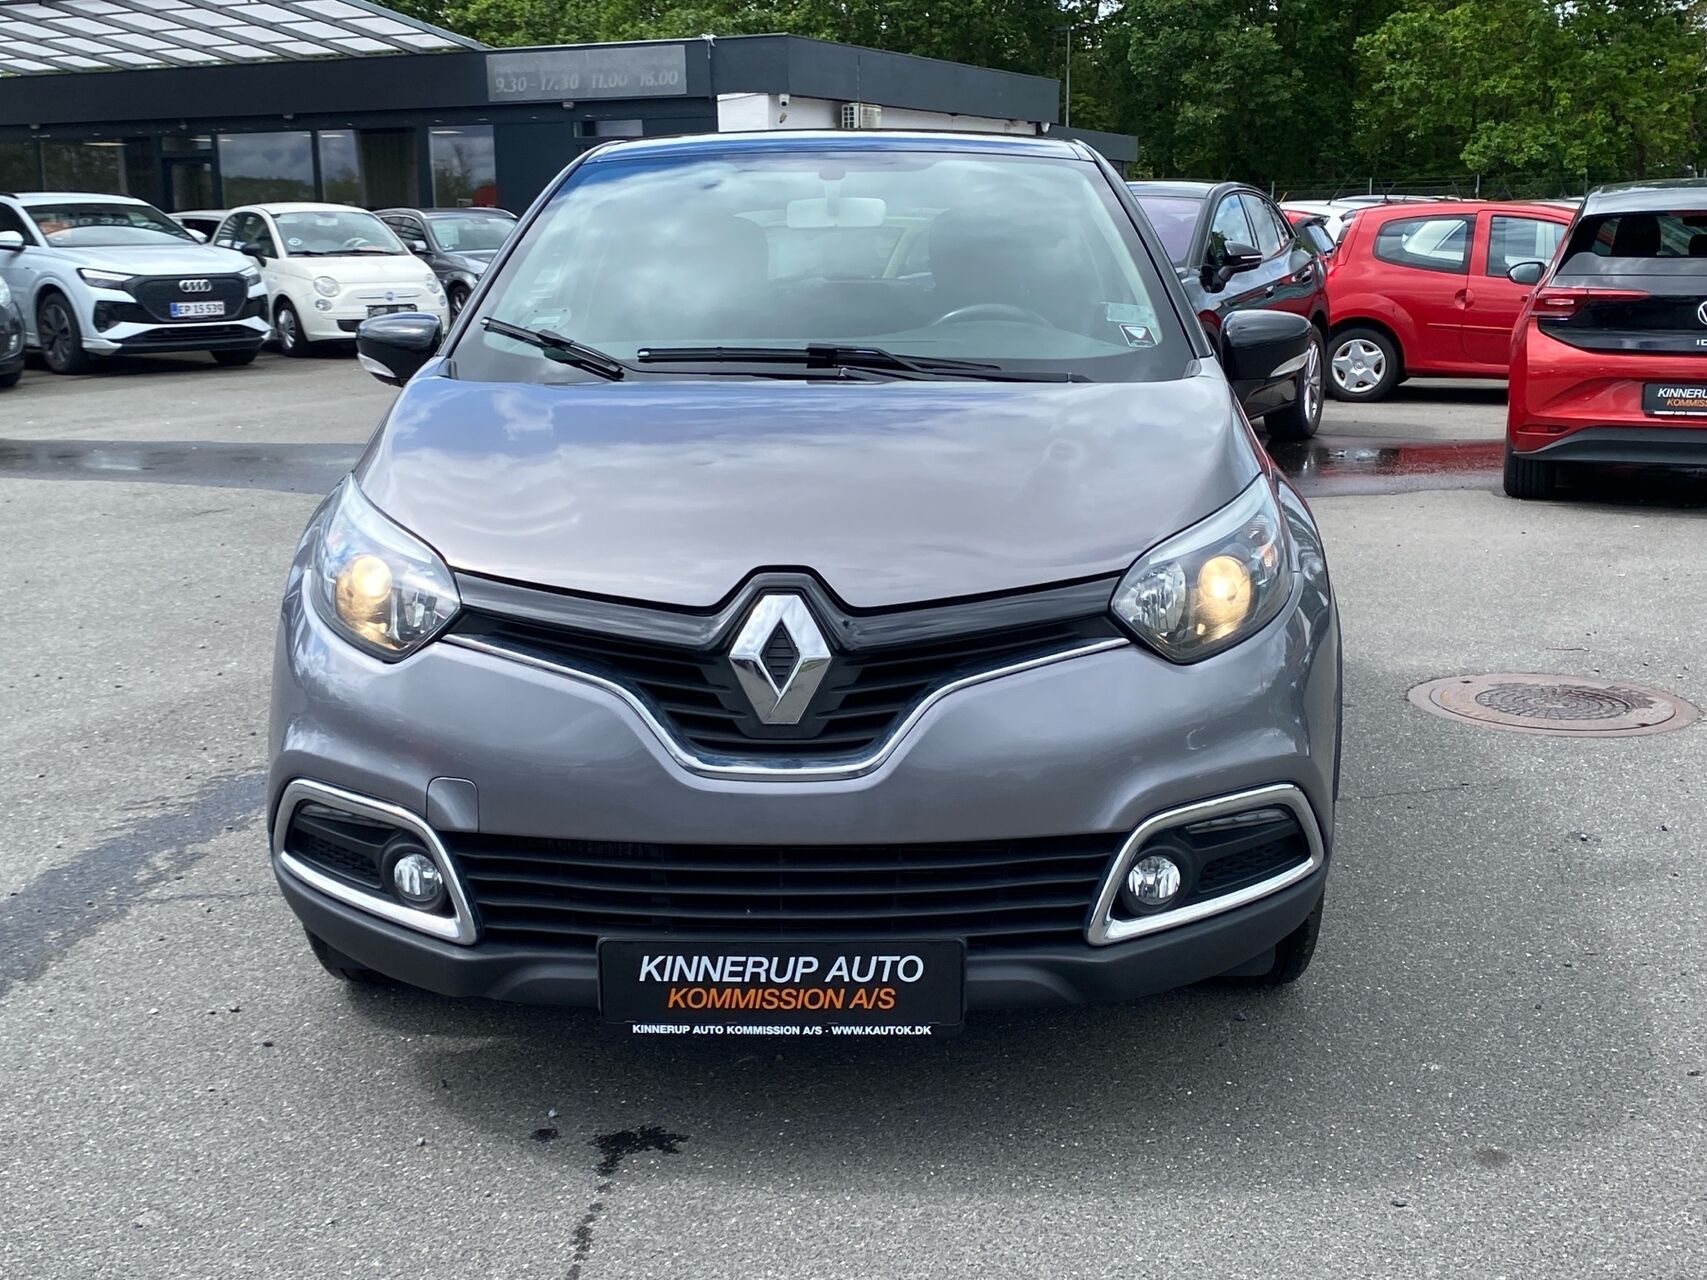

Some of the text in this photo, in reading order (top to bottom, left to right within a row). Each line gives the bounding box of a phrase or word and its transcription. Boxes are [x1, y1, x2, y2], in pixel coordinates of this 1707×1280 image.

[495, 76, 527, 93] 9.30
[179, 305, 191, 315] EP
[194, 304, 204, 314] 15
[638, 955, 924, 984] KINNERUP AUTO
[667, 987, 896, 1010] KOMMISSION A/S
[632, 1024, 691, 1034] KINNERUP
[692, 1025, 724, 1035] AUTO
[726, 1025, 800, 1035] KOMMISSION
[803, 1025, 822, 1035] A/S
[831, 1025, 932, 1036] WWW.KAUTOK.DK
